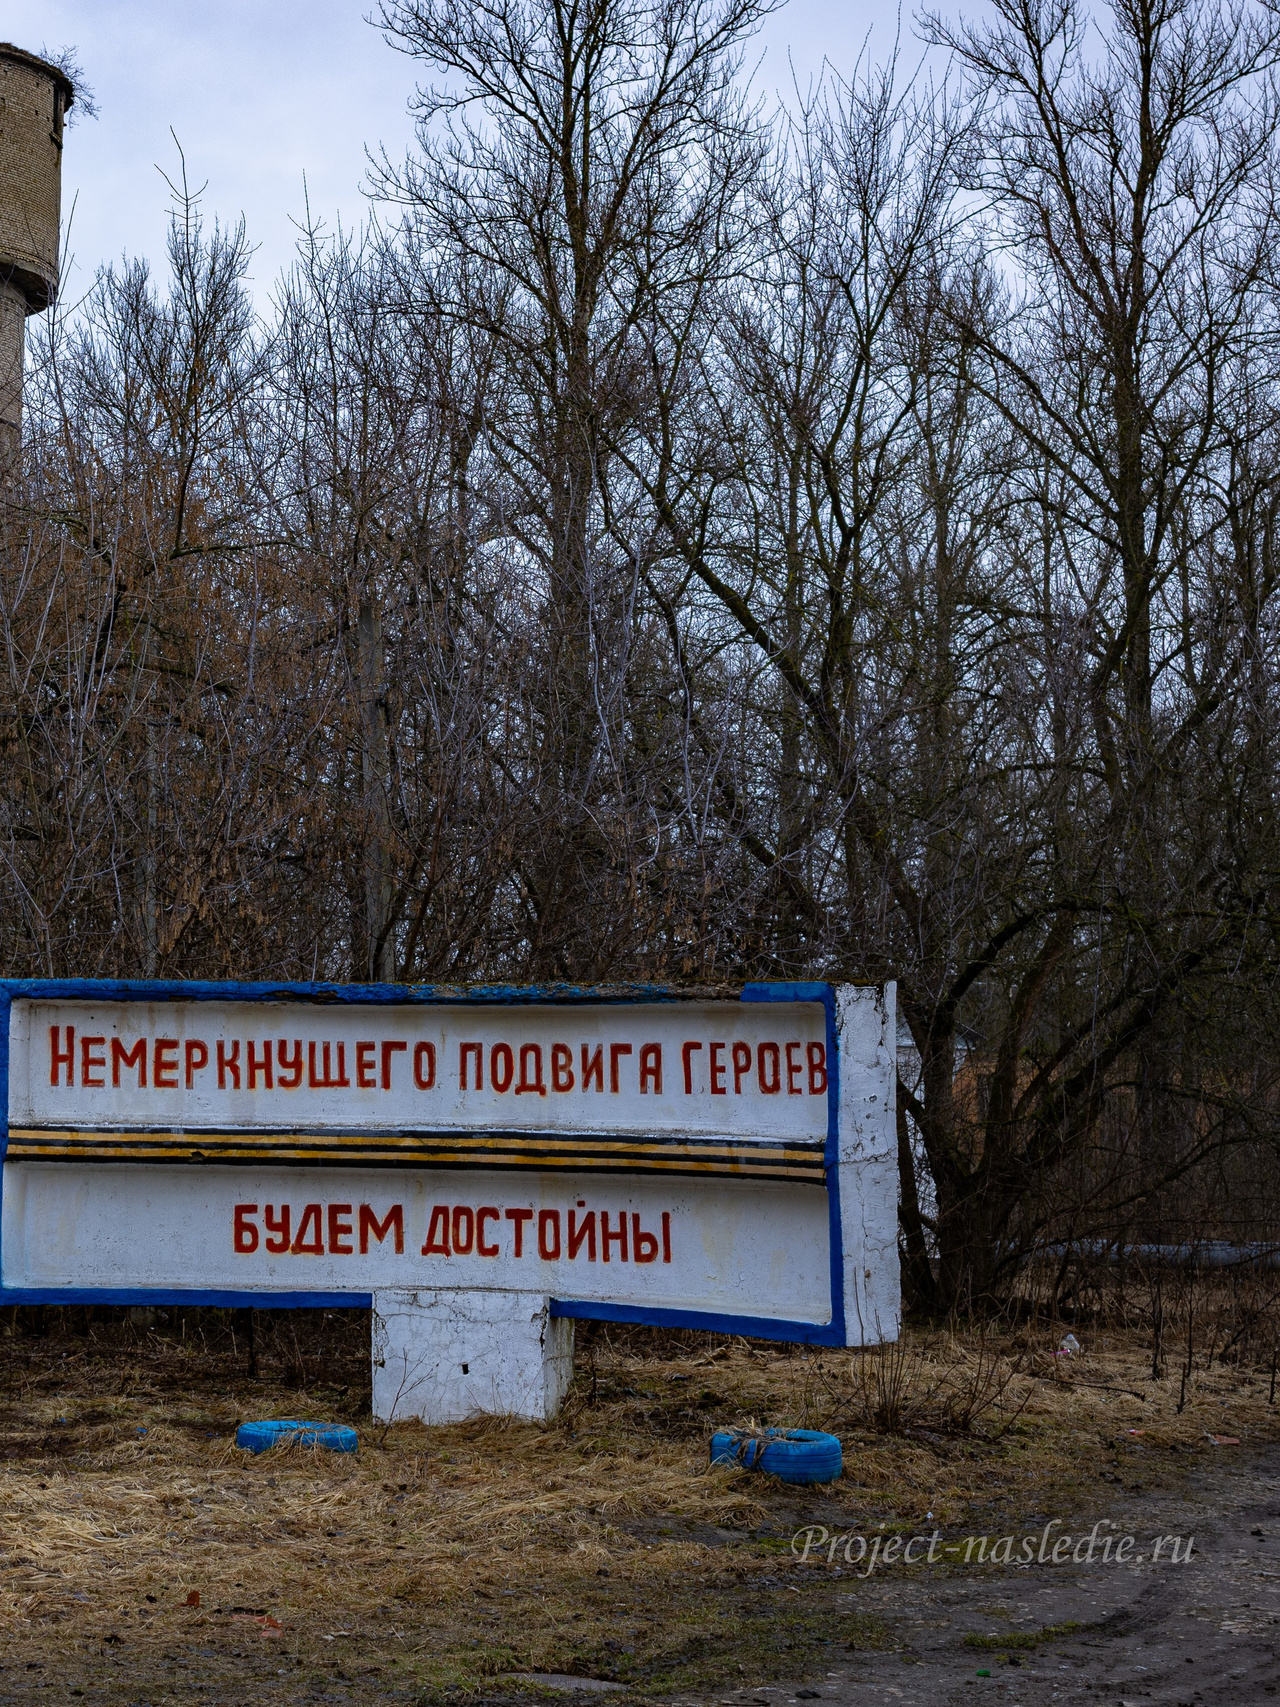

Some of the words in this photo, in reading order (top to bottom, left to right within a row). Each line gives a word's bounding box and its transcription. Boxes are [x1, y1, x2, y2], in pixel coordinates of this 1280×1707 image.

[50, 1025, 436, 1090] НЕМЕРКНУЩЕГО
[458, 1041, 663, 1096] ПОДВИГА
[681, 1041, 829, 1095] ГЕРОЕВ
[233, 1204, 405, 1256] БУДЕМ
[421, 1201, 672, 1264] ДОСТОЙНЫ
